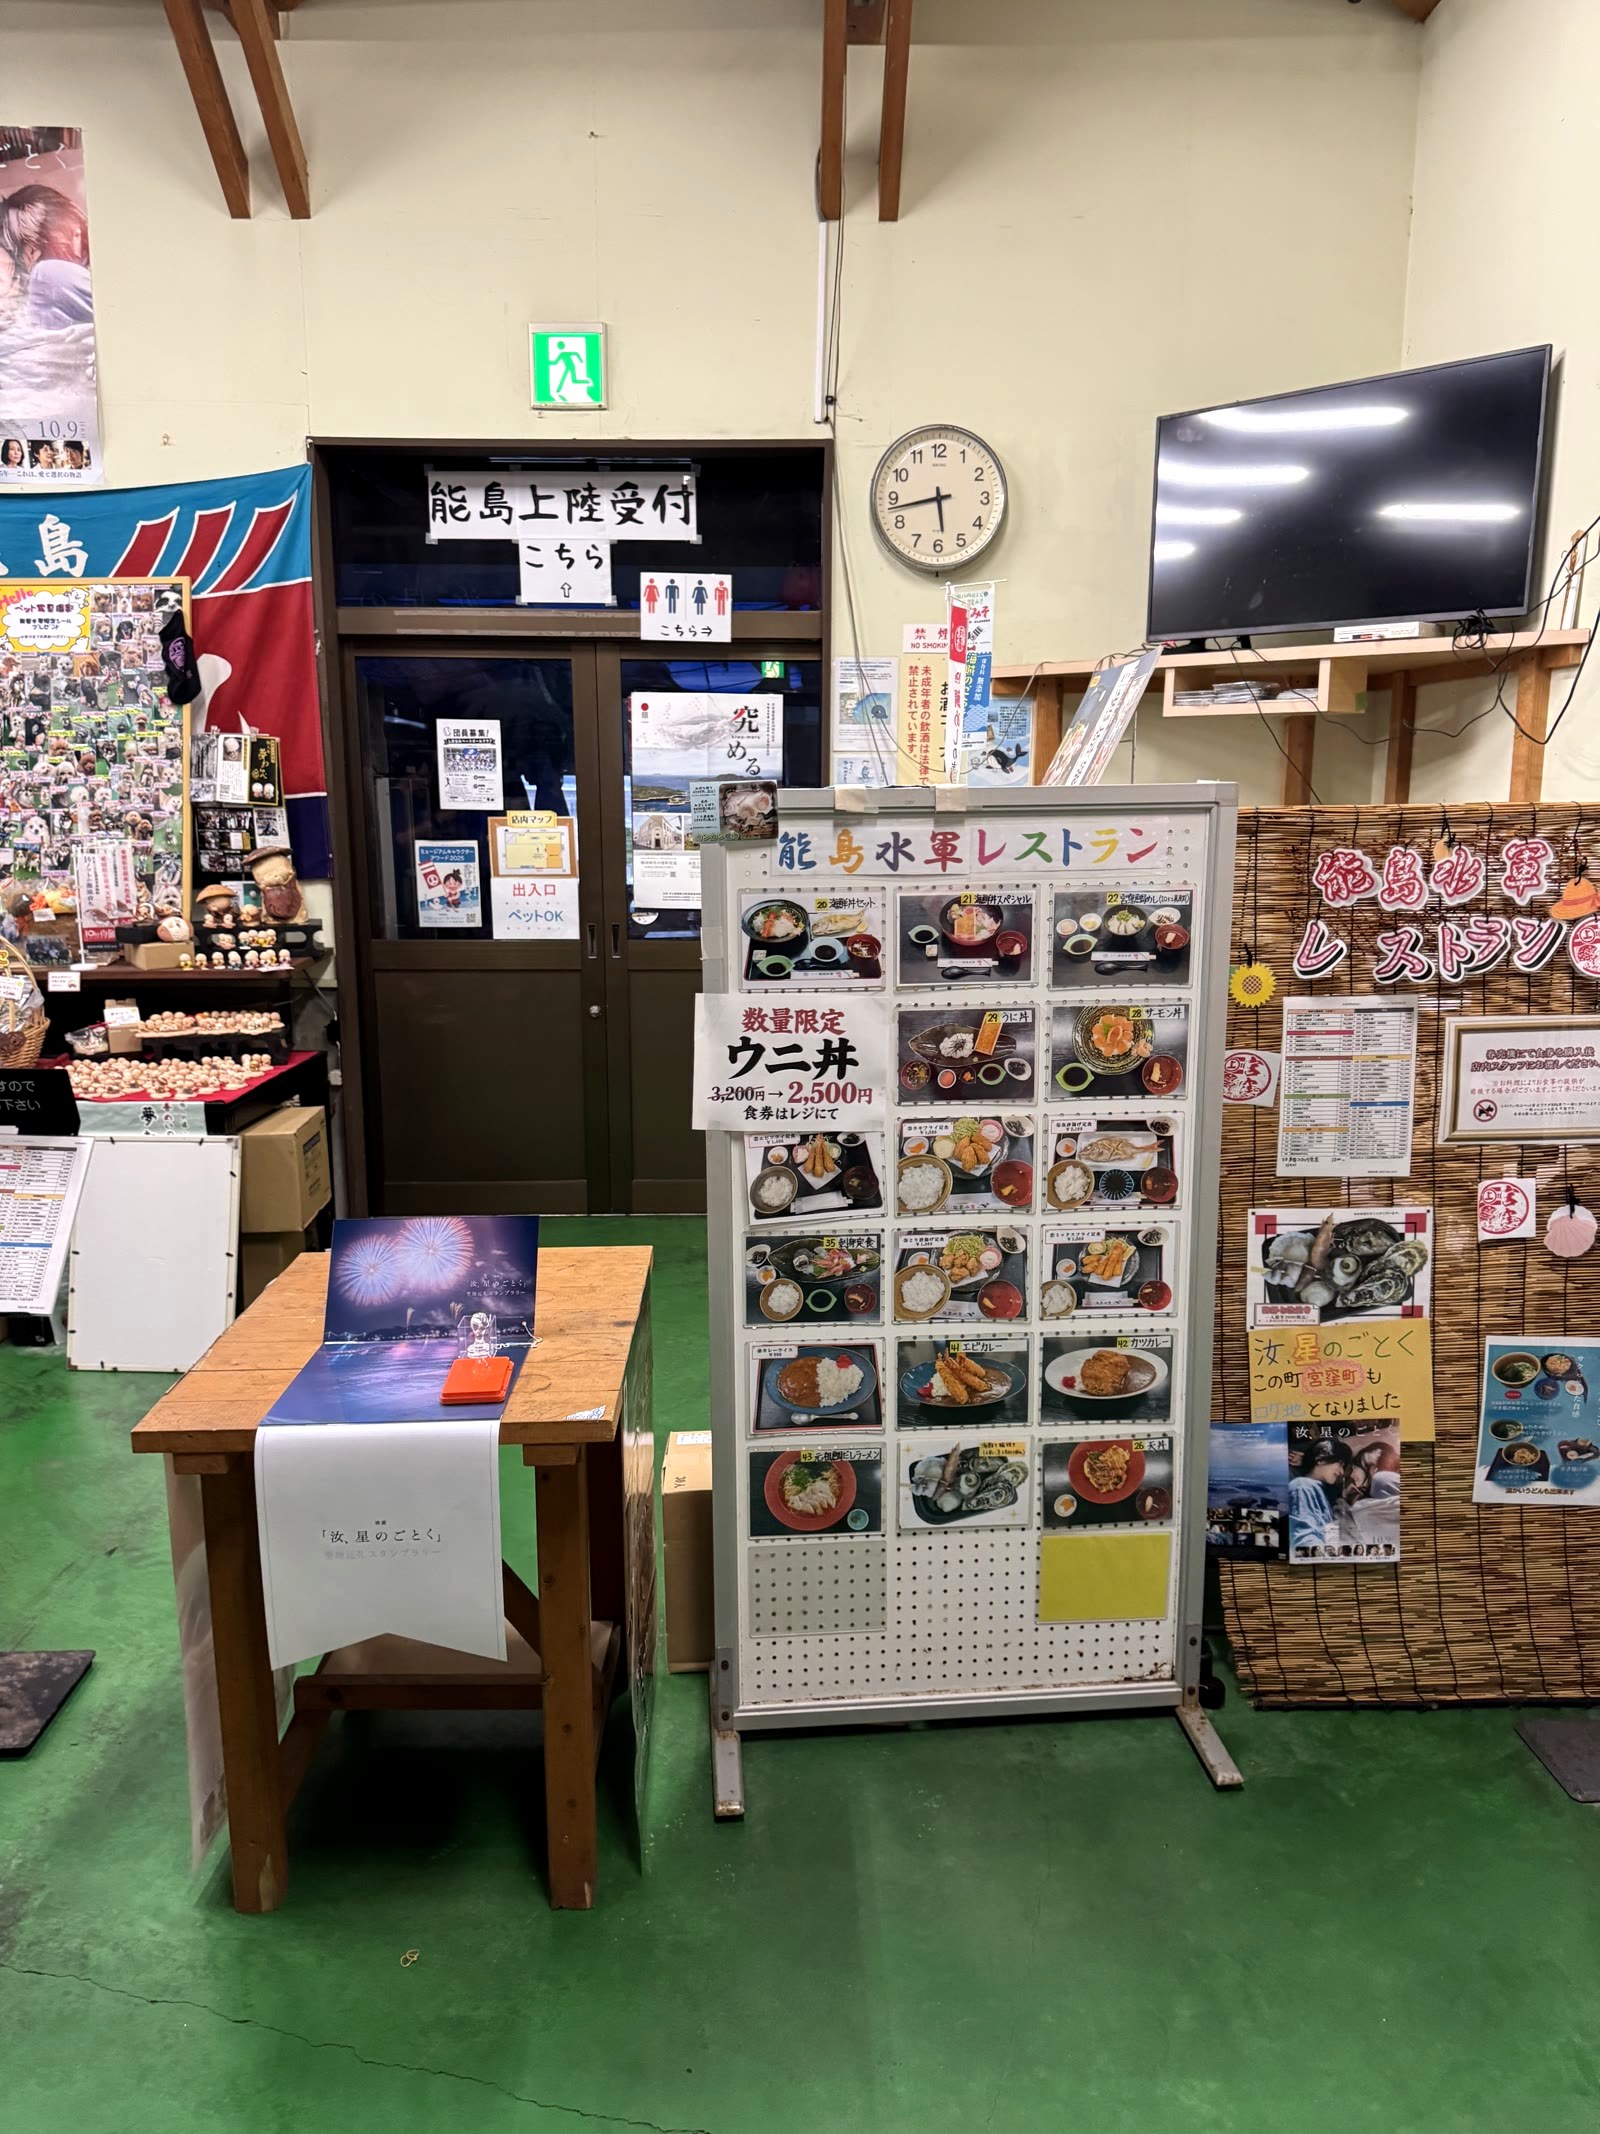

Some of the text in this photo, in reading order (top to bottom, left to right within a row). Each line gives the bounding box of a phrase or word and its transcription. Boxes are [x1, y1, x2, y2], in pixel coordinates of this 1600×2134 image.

[38, 420, 78, 439] 10.9
[910, 450, 923, 464] 11
[931, 443, 947, 458] 12
[960, 449, 966, 464] 1
[893, 468, 909, 482] 10
[974, 467, 984, 482] 2
[430, 480, 694, 526] 能島上陸受付
[888, 491, 899, 505] 9
[980, 491, 990, 505] 3
[894, 515, 905, 529] 8
[972, 516, 983, 530] 4
[912, 534, 922, 548] 7
[933, 539, 943, 553] 6
[956, 533, 966, 548] 5
[525, 543, 605, 571] こちら
[660, 624, 701, 638] こちら
[919, 665, 933, 786] 未成年者の飲酒は法律で
[511, 815, 552, 824] 店内マップ
[777, 827, 1159, 874] 能島水軍レストラン
[1315, 840, 1551, 906] 能島水軍
[513, 883, 556, 897] 出入口
[817, 901, 827, 909] 20
[962, 894, 972, 903] 21
[1107, 893, 1119, 904] 22
[508, 910, 564, 922] ペットOK
[1296, 916, 1560, 980] レストラン
[987, 1011, 1030, 1023] 29 うに丼
[1131, 1006, 1184, 1019] 28 サーモン丼
[741, 1007, 846, 1035] 数量限定
[727, 1036, 859, 1080] ウニ丼
[1486, 1046, 1595, 1060] 券売機にて食券を購入後
[788, 1081, 873, 1104] 2,500円
[0, 1099, 41, 1111] 下さい
[744, 1104, 838, 1120] 食券はレジにて
[825, 1236, 876, 1248] 35 刺身定食
[951, 1342, 1003, 1352] 41 エビカレー
[1118, 1338, 1169, 1349] 42 カツカレー
[1254, 1330, 1414, 1366] 汝、星のごとく
[1254, 1392, 1400, 1420] ロケ地となりました
[1134, 1440, 1167, 1452] 26 天丼
[322, 1528, 441, 1544] 「汝、星のごとく」
